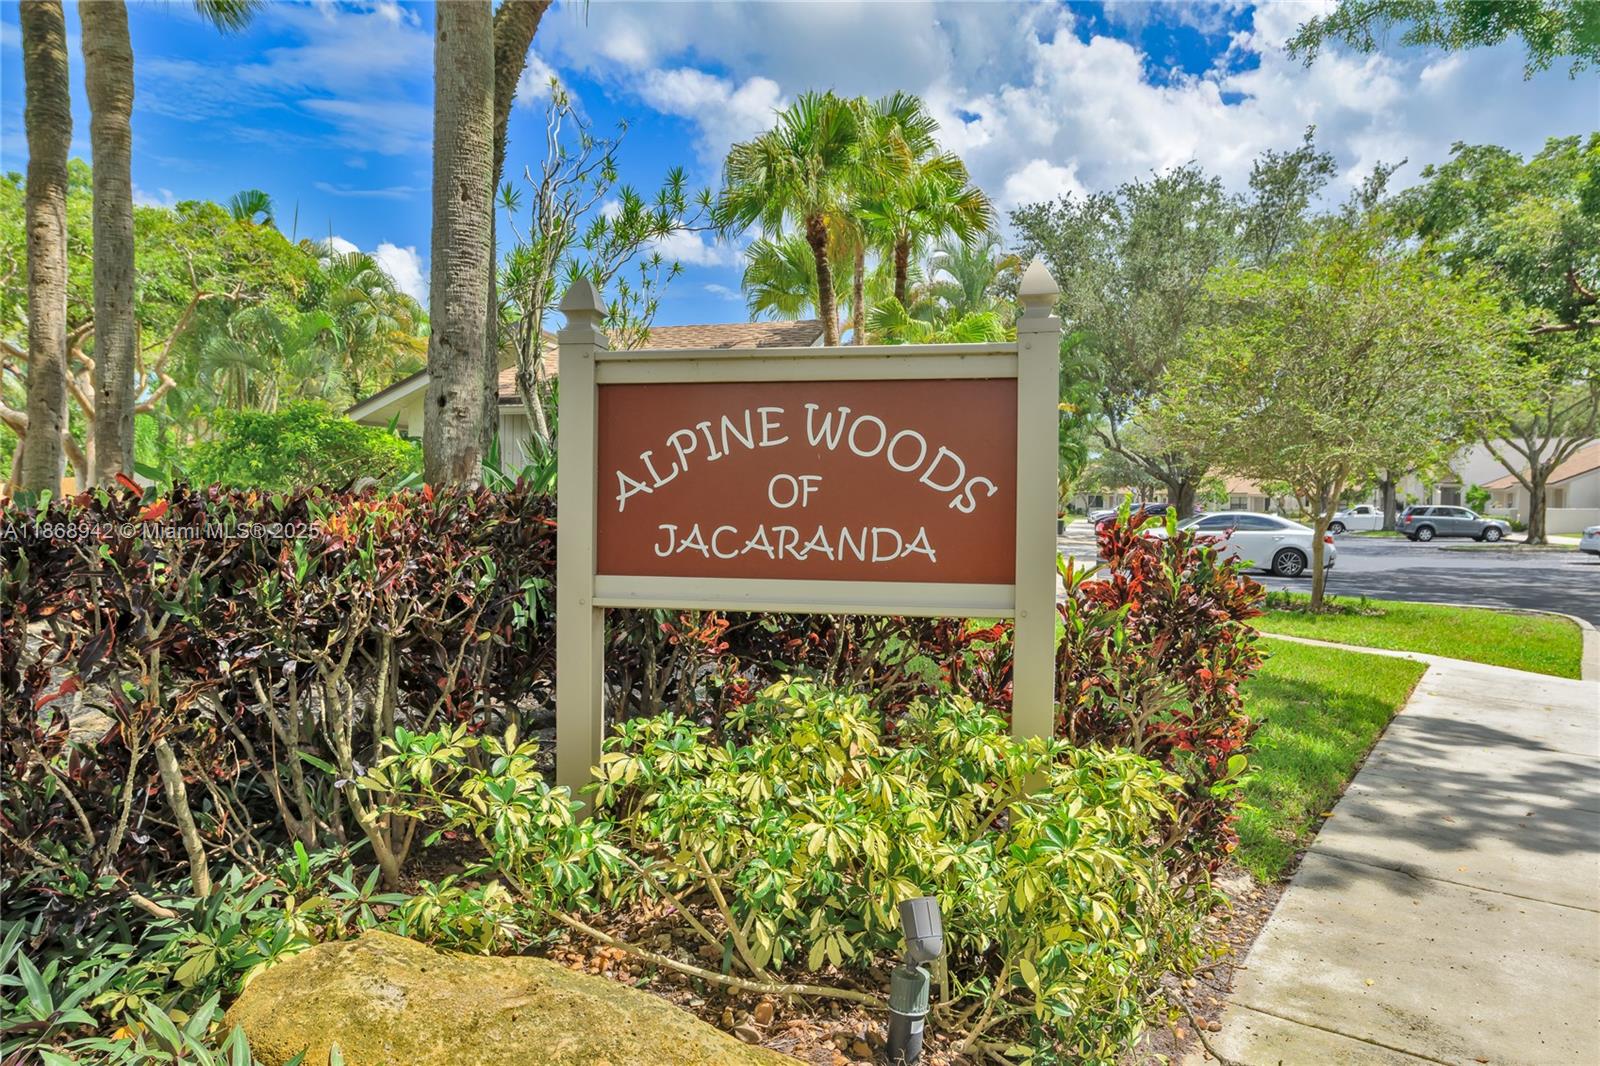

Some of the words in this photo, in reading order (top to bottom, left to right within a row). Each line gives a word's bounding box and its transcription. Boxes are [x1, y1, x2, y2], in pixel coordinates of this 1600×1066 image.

[615, 406, 789, 512] ALPINE
[804, 403, 998, 514] WOODS
[768, 473, 822, 508] OF
[654, 523, 937, 563] JACARANDA
